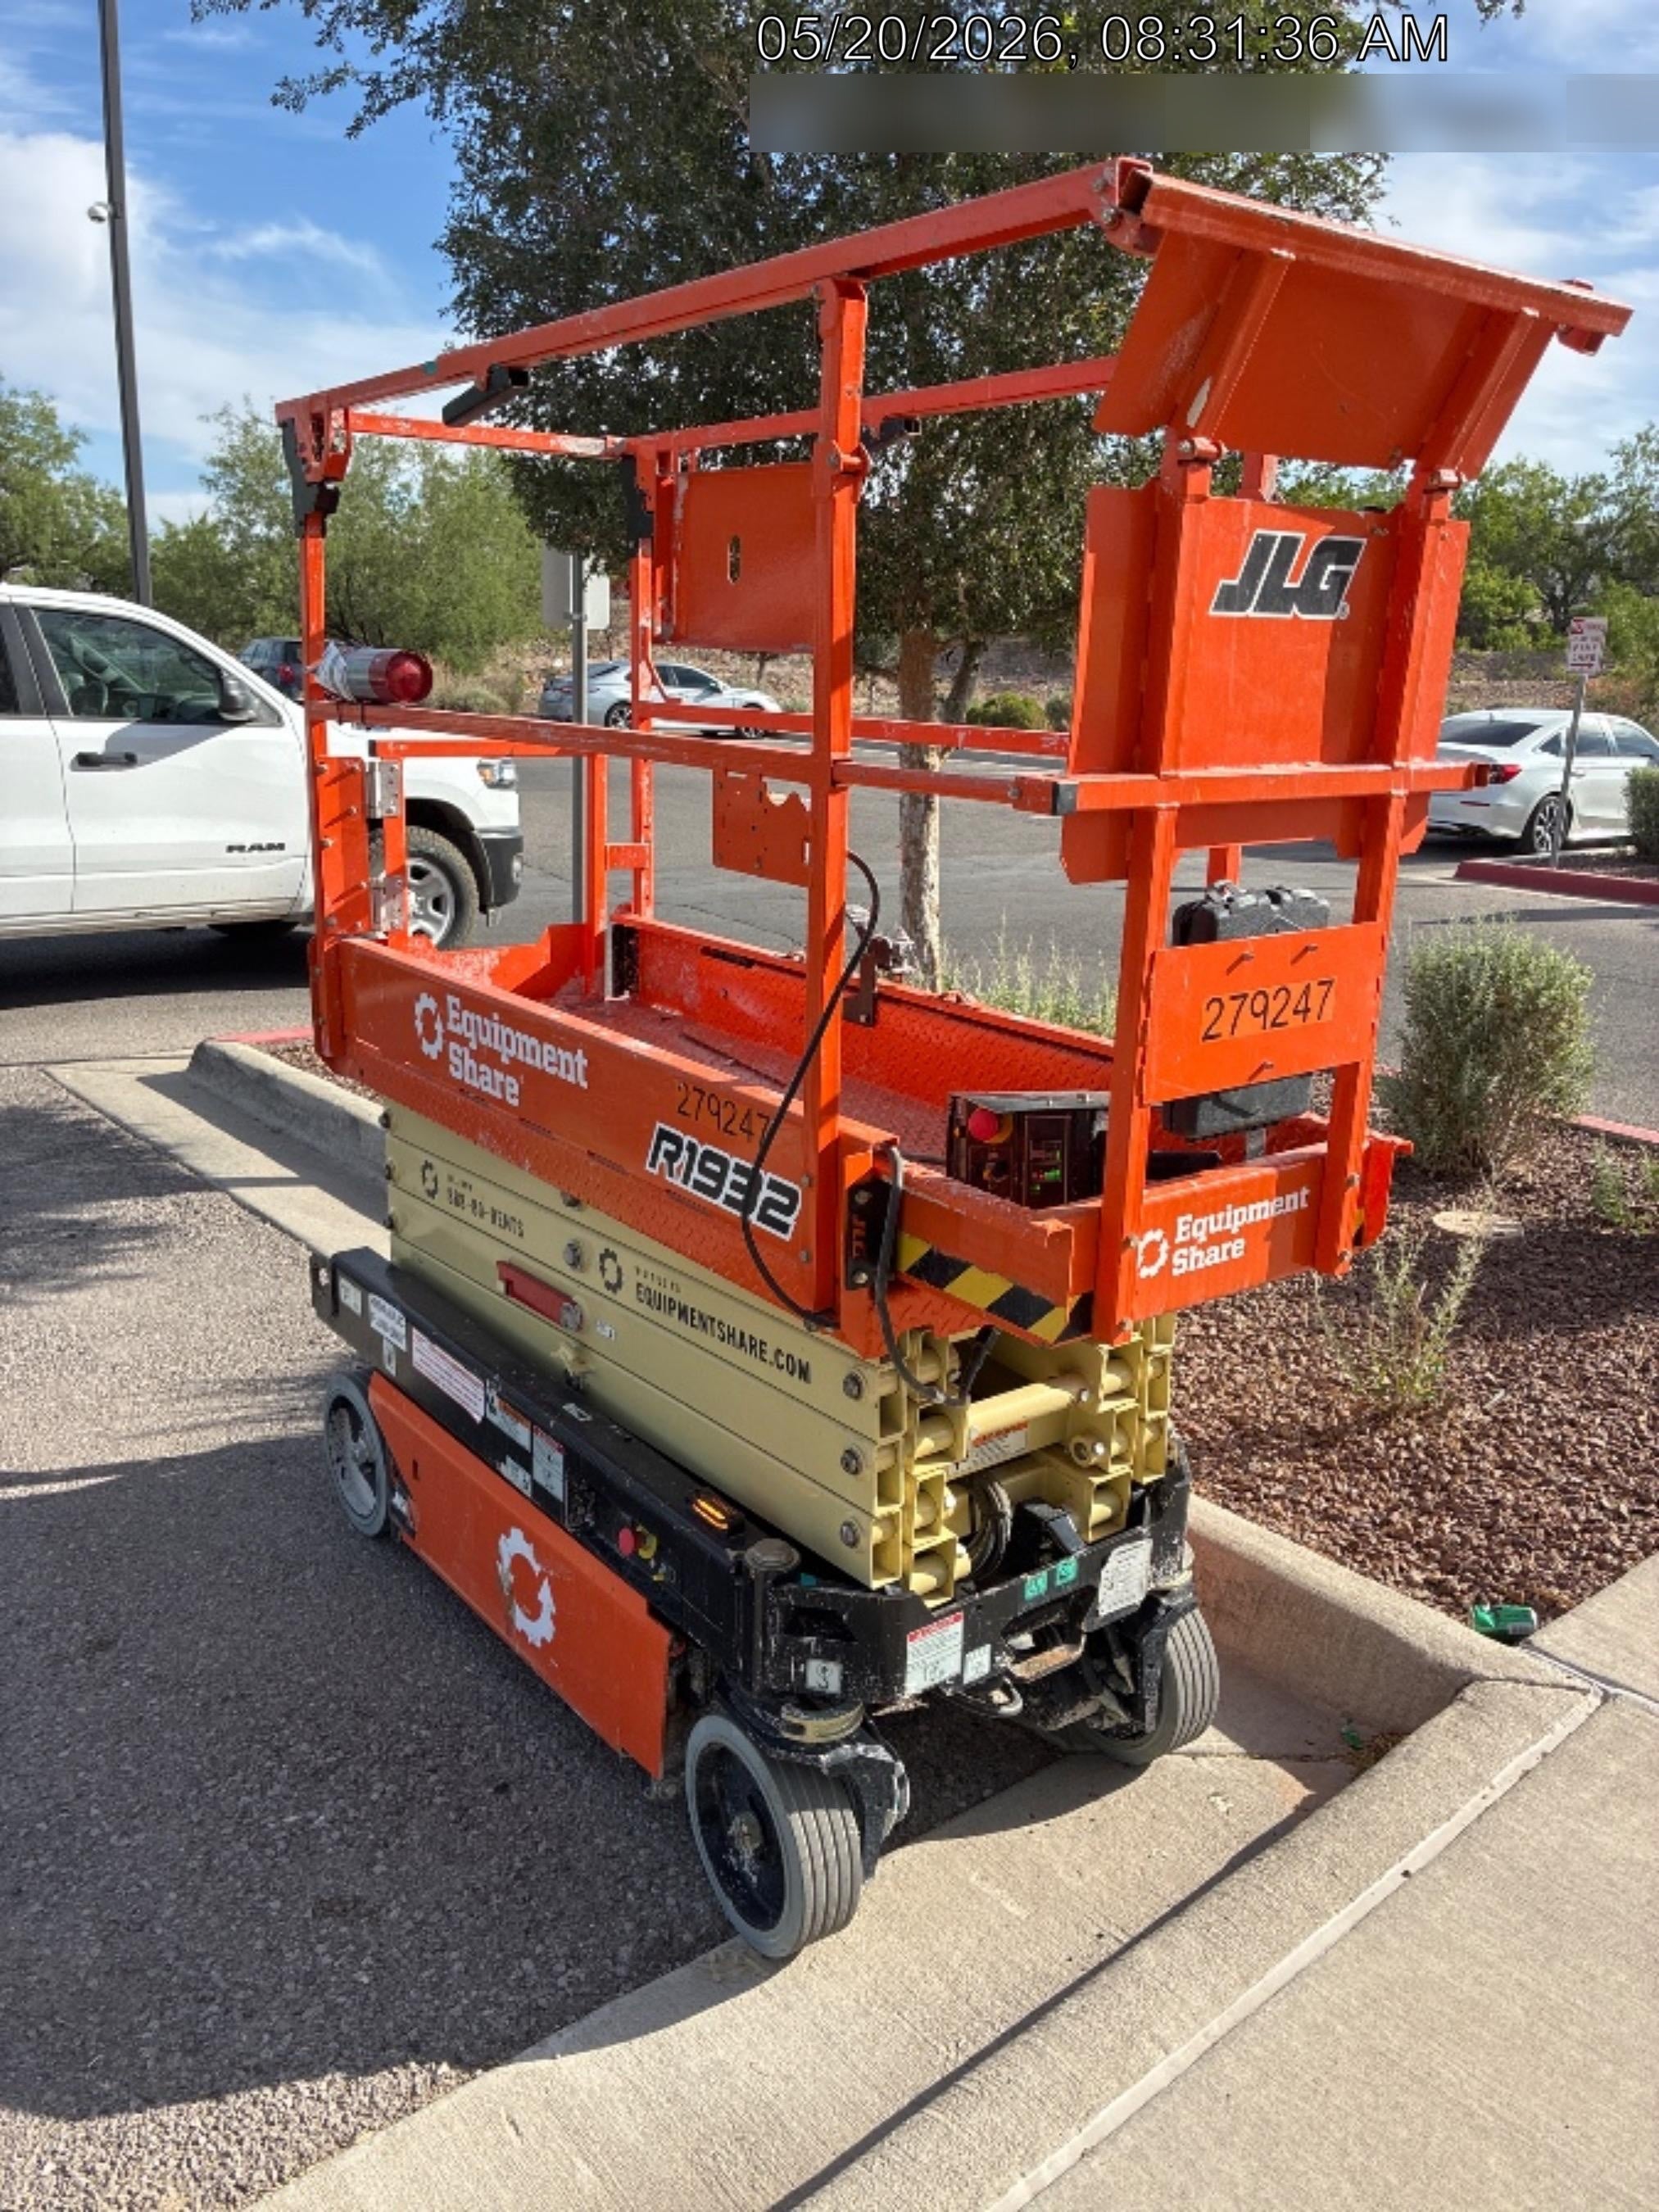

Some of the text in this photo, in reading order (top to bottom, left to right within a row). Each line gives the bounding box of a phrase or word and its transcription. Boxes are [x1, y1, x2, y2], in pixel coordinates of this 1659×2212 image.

[1209, 528, 1367, 620] JLG
[225, 842, 286, 854] RAM
[446, 995, 588, 1090] Equipment
[1202, 978, 1335, 1042] 279247
[449, 1040, 520, 1107] Share
[677, 1082, 771, 1142] 279247
[646, 1121, 803, 1242] R1932
[1174, 1186, 1310, 1243] Equipment
[1172, 1237, 1245, 1276] Share
[636, 1282, 812, 1385] EQUIPMENTSHARE.COM
